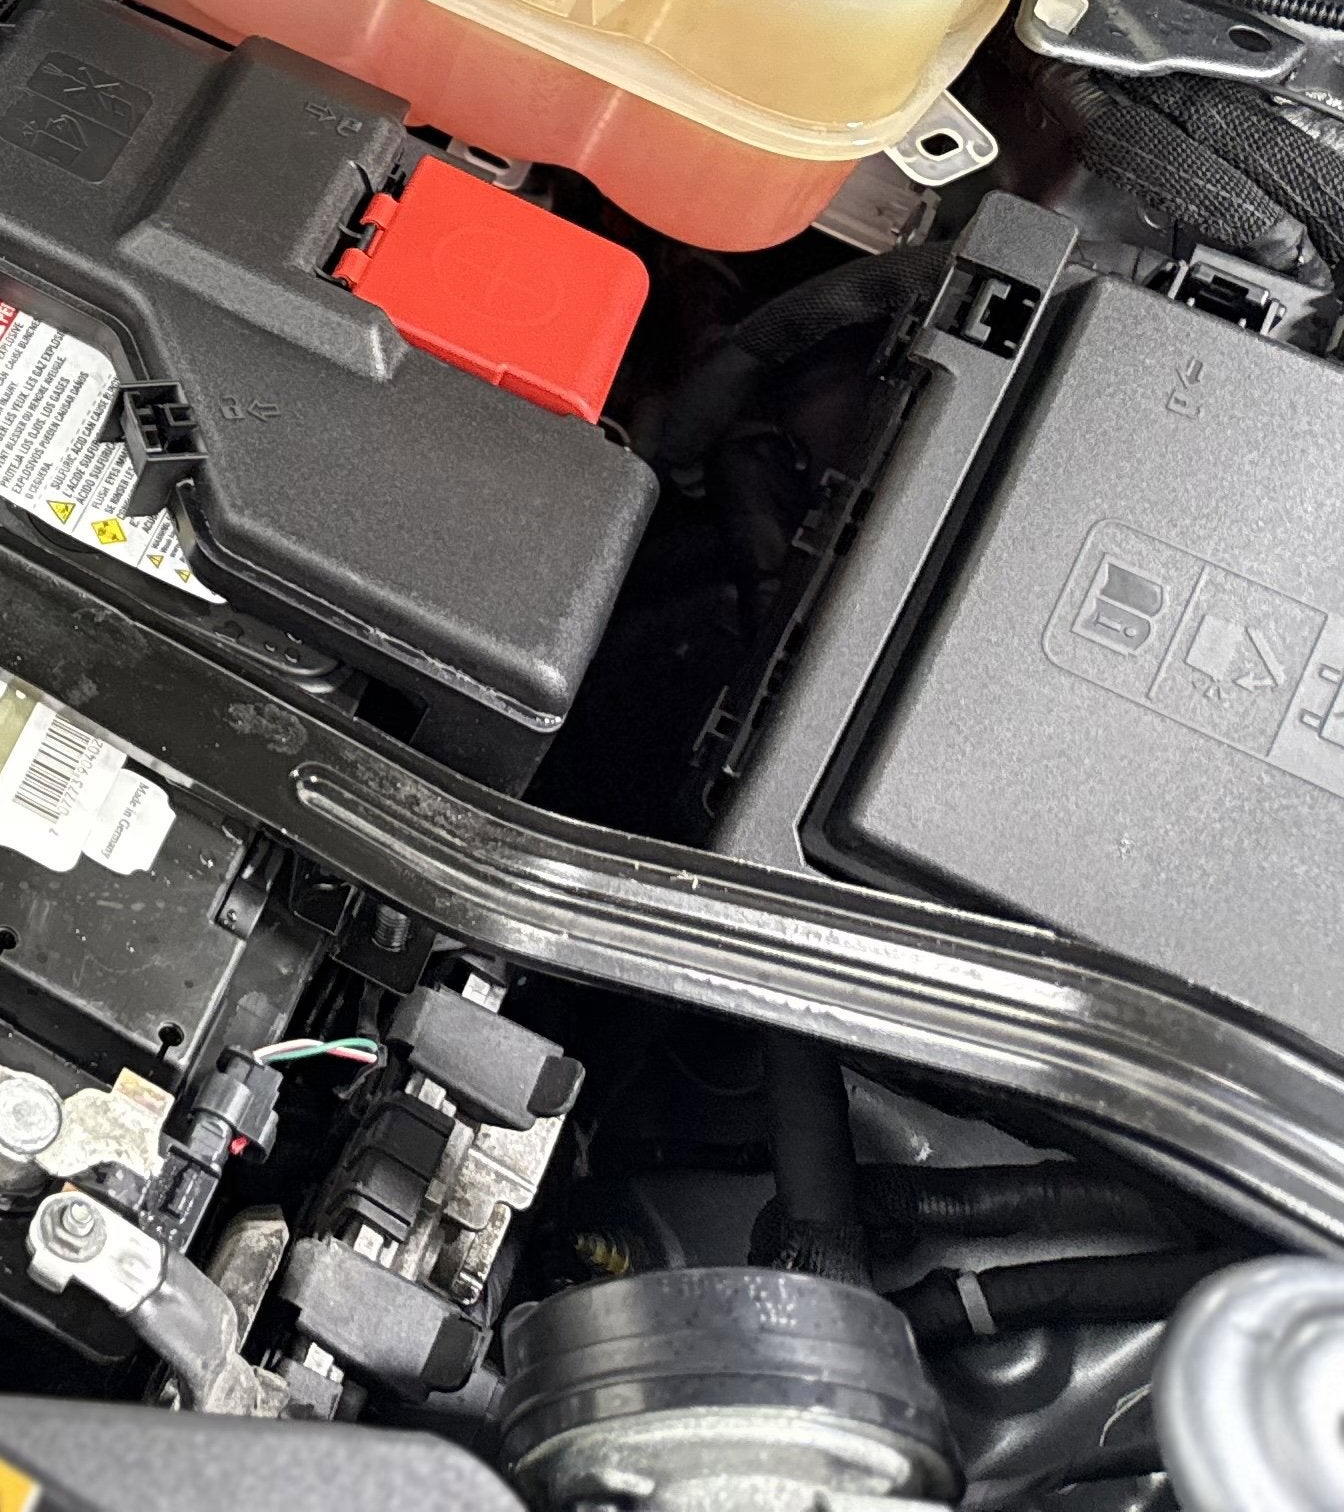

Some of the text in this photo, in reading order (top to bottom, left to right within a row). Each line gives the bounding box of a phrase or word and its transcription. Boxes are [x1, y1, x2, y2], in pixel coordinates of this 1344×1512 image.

[2, 411, 18, 427] LES
[23, 376, 39, 392] LES
[31, 360, 48, 378] GAZ
[0, 454, 25, 488] PROTEJA
[19, 438, 34, 455] LOS
[40, 401, 56, 418] LOS
[49, 376, 71, 403] GASES
[5, 420, 27, 451] BLESSER
[11, 447, 45, 494] EXPLOSIVOS
[39, 421, 61, 449] PUEDEN
[54, 394, 76, 422] CAUSAR
[50, 454, 77, 491] SULFURIC
[71, 436, 88, 456] ACID
[82, 421, 97, 438] CAN
[104, 467, 121, 486] EYES
[101, 782, 150, 859] Made in Germany
